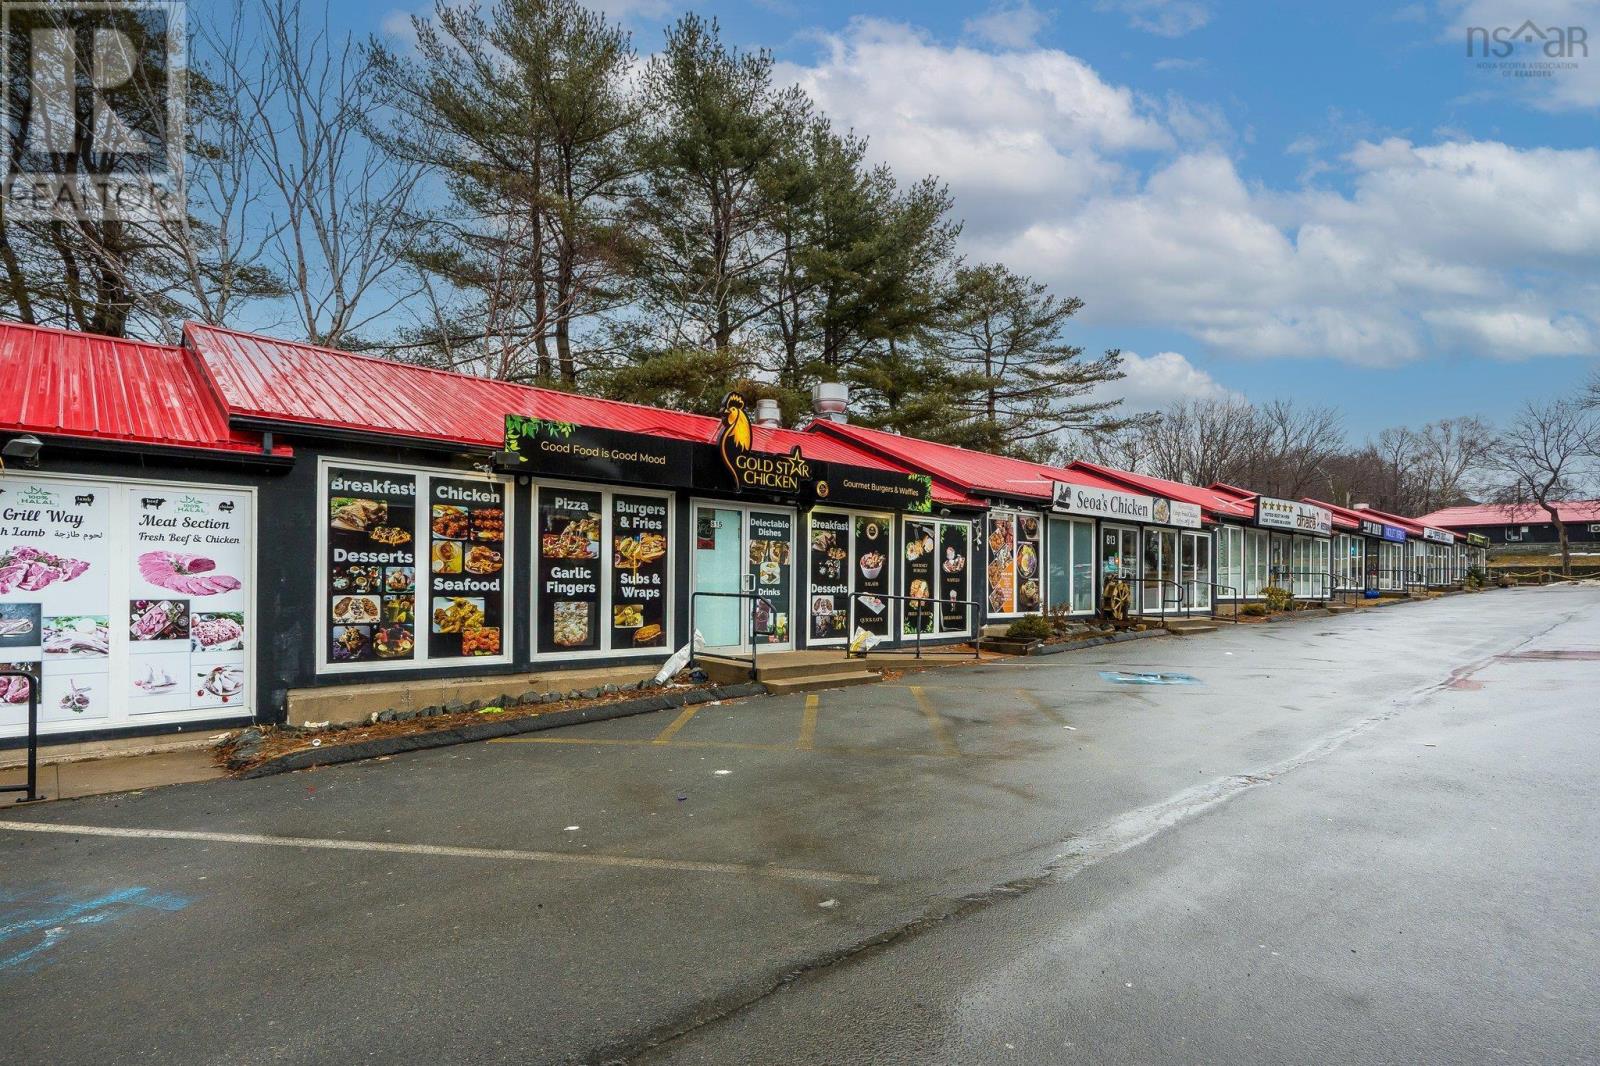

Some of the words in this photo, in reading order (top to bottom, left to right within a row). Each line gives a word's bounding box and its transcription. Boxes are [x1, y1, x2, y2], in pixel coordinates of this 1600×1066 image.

[540, 441, 570, 454] Good
[573, 442, 599, 456] Food
[601, 447, 610, 458] is
[611, 449, 638, 461] Good
[639, 452, 666, 465] Mood
[736, 455, 773, 472] GOLD
[330, 477, 416, 496] Breakfast
[744, 471, 798, 489] CHICKEN
[843, 479, 870, 490] Gourmet
[871, 483, 894, 494] Burgers
[899, 487, 919, 496] Waffles
[436, 486, 500, 503] Chicken
[554, 497, 589, 512] Pizza
[616, 500, 666, 518] Burgers
[1076, 490, 1108, 510] Seoa's
[1110, 496, 1148, 517] Chicken
[3, 508, 41, 522] Grill
[46, 510, 84, 528] Way
[138, 514, 178, 528] Meat
[182, 516, 230, 530] Section
[620, 516, 630, 529] &
[632, 516, 662, 530] Fries
[750, 518, 789, 529] Delectable
[811, 519, 849, 532] Breakfast
[12, 526, 46, 537] Lamb
[138, 532, 165, 542] Fresh
[168, 533, 192, 546] Beef
[192, 534, 202, 543] &
[205, 534, 240, 544] Chicken
[758, 528, 782, 537] Dishes
[333, 548, 414, 564] Desserts
[550, 566, 592, 580] Garlic
[620, 572, 649, 586] Subs
[651, 574, 661, 584] &
[433, 577, 500, 592] Seafood
[546, 580, 596, 598] Fingers
[758, 588, 780, 596] Drinks
[811, 583, 848, 594] Desserts
[622, 586, 660, 601] Wraps
